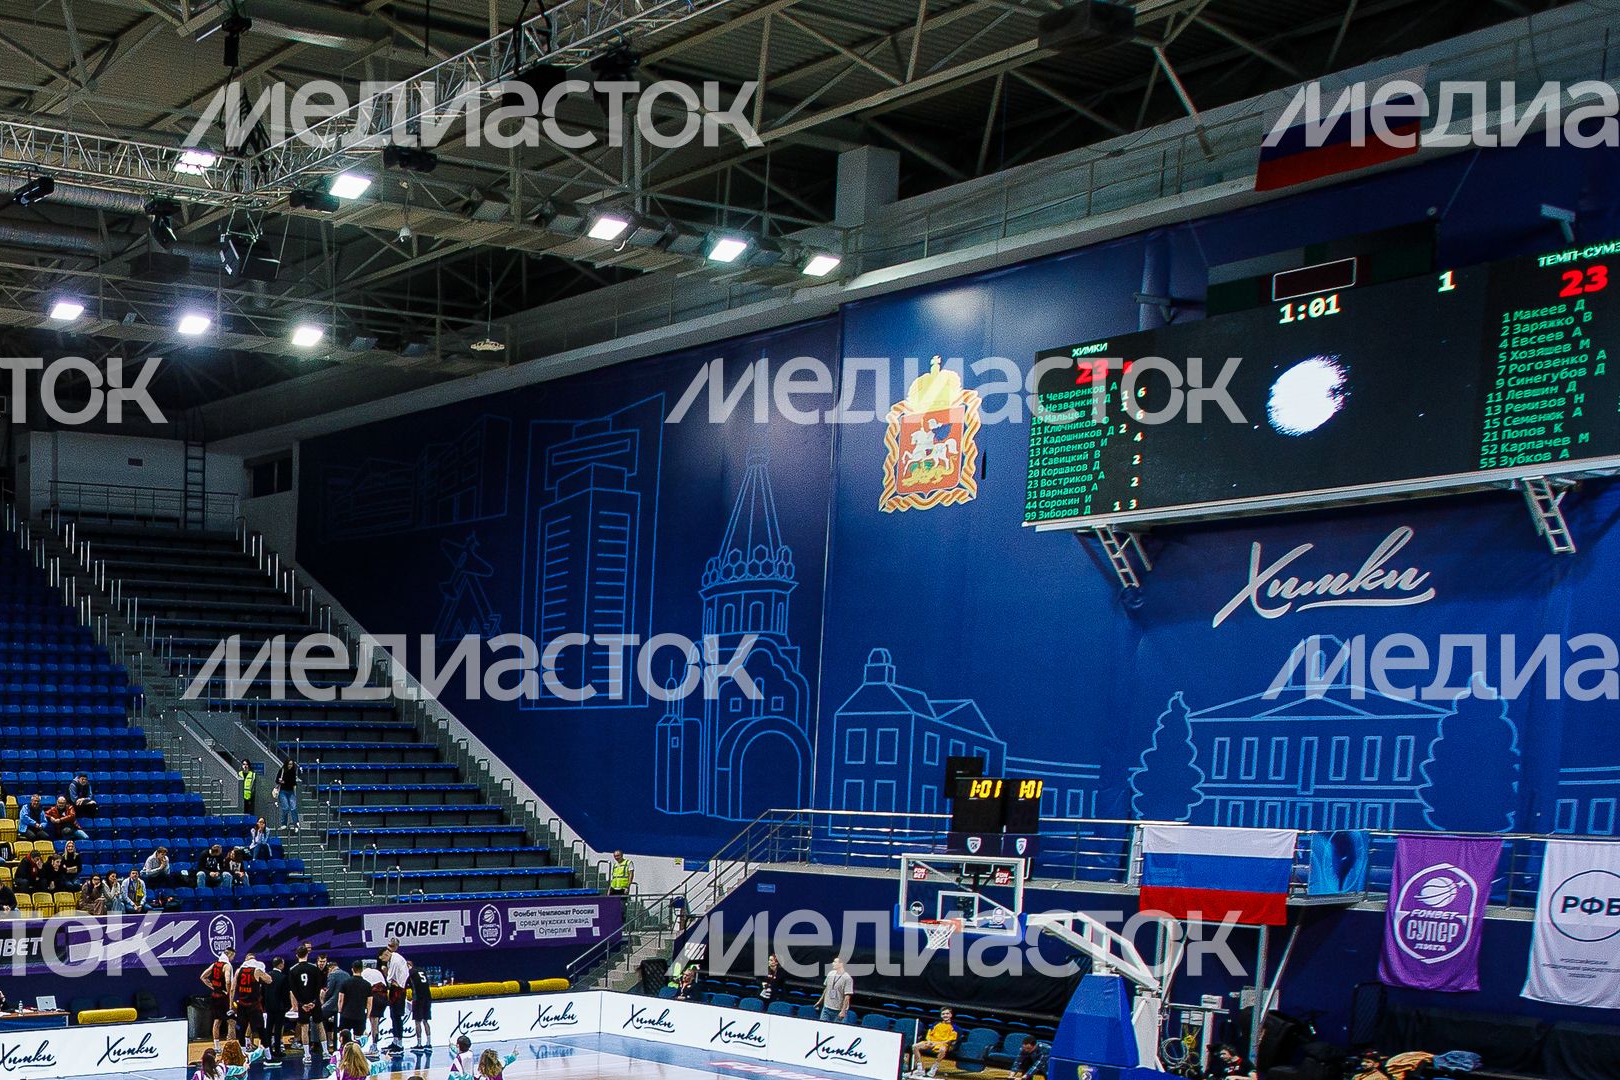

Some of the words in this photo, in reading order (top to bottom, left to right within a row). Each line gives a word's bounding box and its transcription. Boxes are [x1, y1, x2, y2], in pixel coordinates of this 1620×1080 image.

[1437, 271, 1455, 292] 1
[1559, 265, 1608, 297] 23
[1279, 294, 1340, 324] 1:01
[1501, 312, 1511, 323] 1
[1512, 303, 1567, 321] Макеев
[1574, 299, 1585, 312] Д
[1500, 325, 1510, 336] 2
[1512, 316, 1575, 334] Заряжко
[1582, 311, 1593, 322] В
[1498, 338, 1509, 349] 4
[1511, 331, 1565, 348] Евсеев
[1571, 326, 1583, 337] А
[1071, 342, 1108, 357] ХИМКИ
[1498, 351, 1508, 363] 5
[1578, 338, 1591, 350] М
[1075, 359, 1109, 385] 23
[1497, 365, 1506, 376] 7
[1508, 353, 1589, 375] Рогозенко
[1595, 349, 1607, 360] А
[1495, 378, 1505, 389] 9
[1593, 362, 1606, 376] Д
[1046, 385, 1105, 401] Чеваренков
[1486, 391, 1503, 403] 11
[1505, 385, 1559, 401] Левшин
[1565, 380, 1577, 393] Д
[1045, 397, 1099, 412] Незванкин
[1484, 405, 1502, 417] 13
[1504, 397, 1567, 414] Ремизов
[1573, 393, 1585, 404] Н
[1031, 427, 1042, 436] 11
[1043, 419, 1097, 434] Ключников
[1483, 417, 1500, 430] 15
[1571, 406, 1583, 418] А
[1029, 438, 1041, 447] 12
[1043, 429, 1102, 445] Кадошников
[1481, 431, 1499, 443] 21
[1501, 426, 1546, 440] Попов
[1553, 422, 1564, 433] К
[1029, 448, 1040, 457] 13
[1042, 441, 1095, 456] Карпенков
[1480, 444, 1498, 456] 52
[1500, 436, 1571, 453] Карпачев
[1577, 432, 1590, 444] М
[1028, 459, 1040, 468] 14
[1479, 457, 1496, 469] 55
[1499, 451, 1552, 467] Зубков
[1559, 448, 1570, 459] А
[1026, 480, 1039, 489] 23
[1040, 473, 1093, 488] Востриков
[1041, 463, 1088, 478] Коршаков
[1026, 491, 1037, 500] 31
[1040, 485, 1087, 498] Варнаков
[1024, 512, 1037, 520] 99
[1038, 508, 1079, 520] Зиборов
[1025, 501, 1037, 510] 44
[1038, 497, 1080, 509] Сорокин
[1212, 525, 1436, 628] Химки
[969, 779, 1003, 798] 1:01
[1018, 780, 1043, 799] 1:01
[572, 907, 595, 915] России
[1410, 908, 1460, 920] FONBET
[384, 919, 449, 938] FONBET
[1406, 919, 1461, 943] СУПЕР
[1413, 943, 1447, 951] ЛИГА
[300, 973, 308, 986] 9
[450, 1007, 499, 1038] Химки
[530, 1001, 578, 1031] Химки
[622, 1004, 675, 1032] Химки
[710, 1016, 766, 1048] Химки
[97, 1033, 159, 1066] Химки
[805, 1031, 867, 1064] Химки
